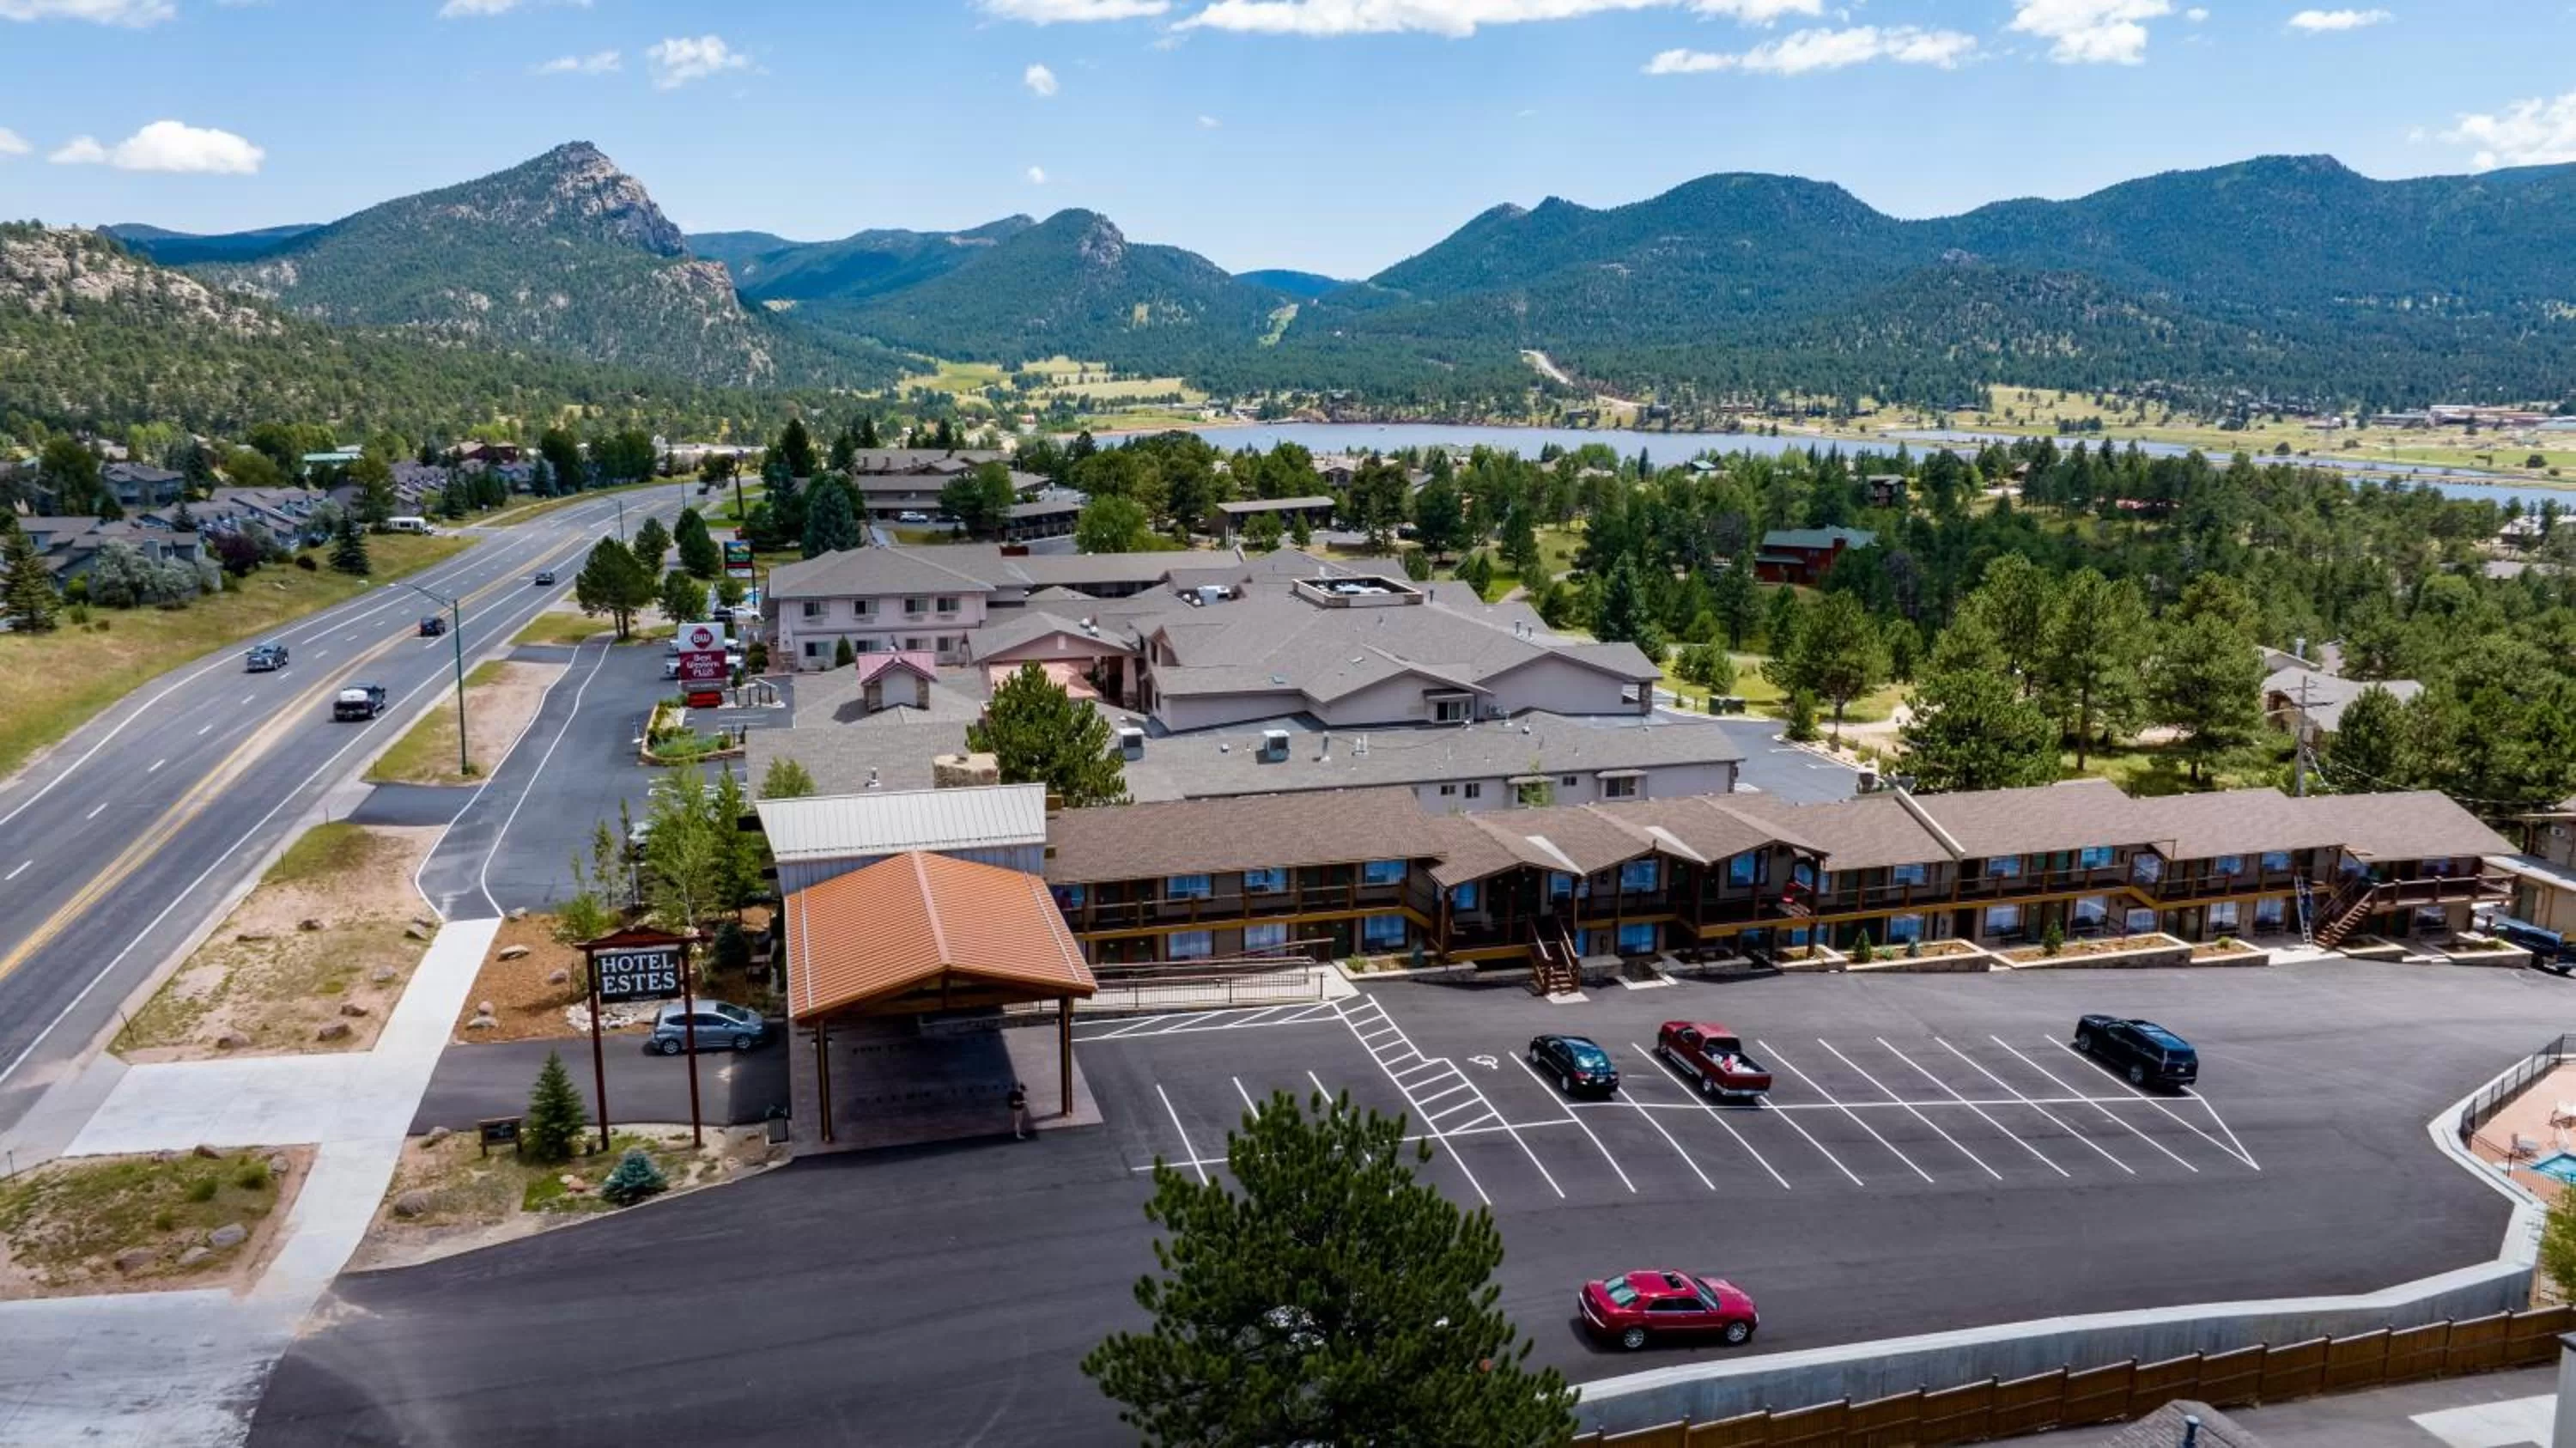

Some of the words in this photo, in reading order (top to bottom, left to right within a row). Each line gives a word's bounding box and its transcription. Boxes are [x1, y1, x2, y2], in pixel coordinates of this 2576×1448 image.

[693, 633, 710, 642] BW
[601, 952, 674, 973] HOTEL
[602, 971, 676, 995] ESTES
